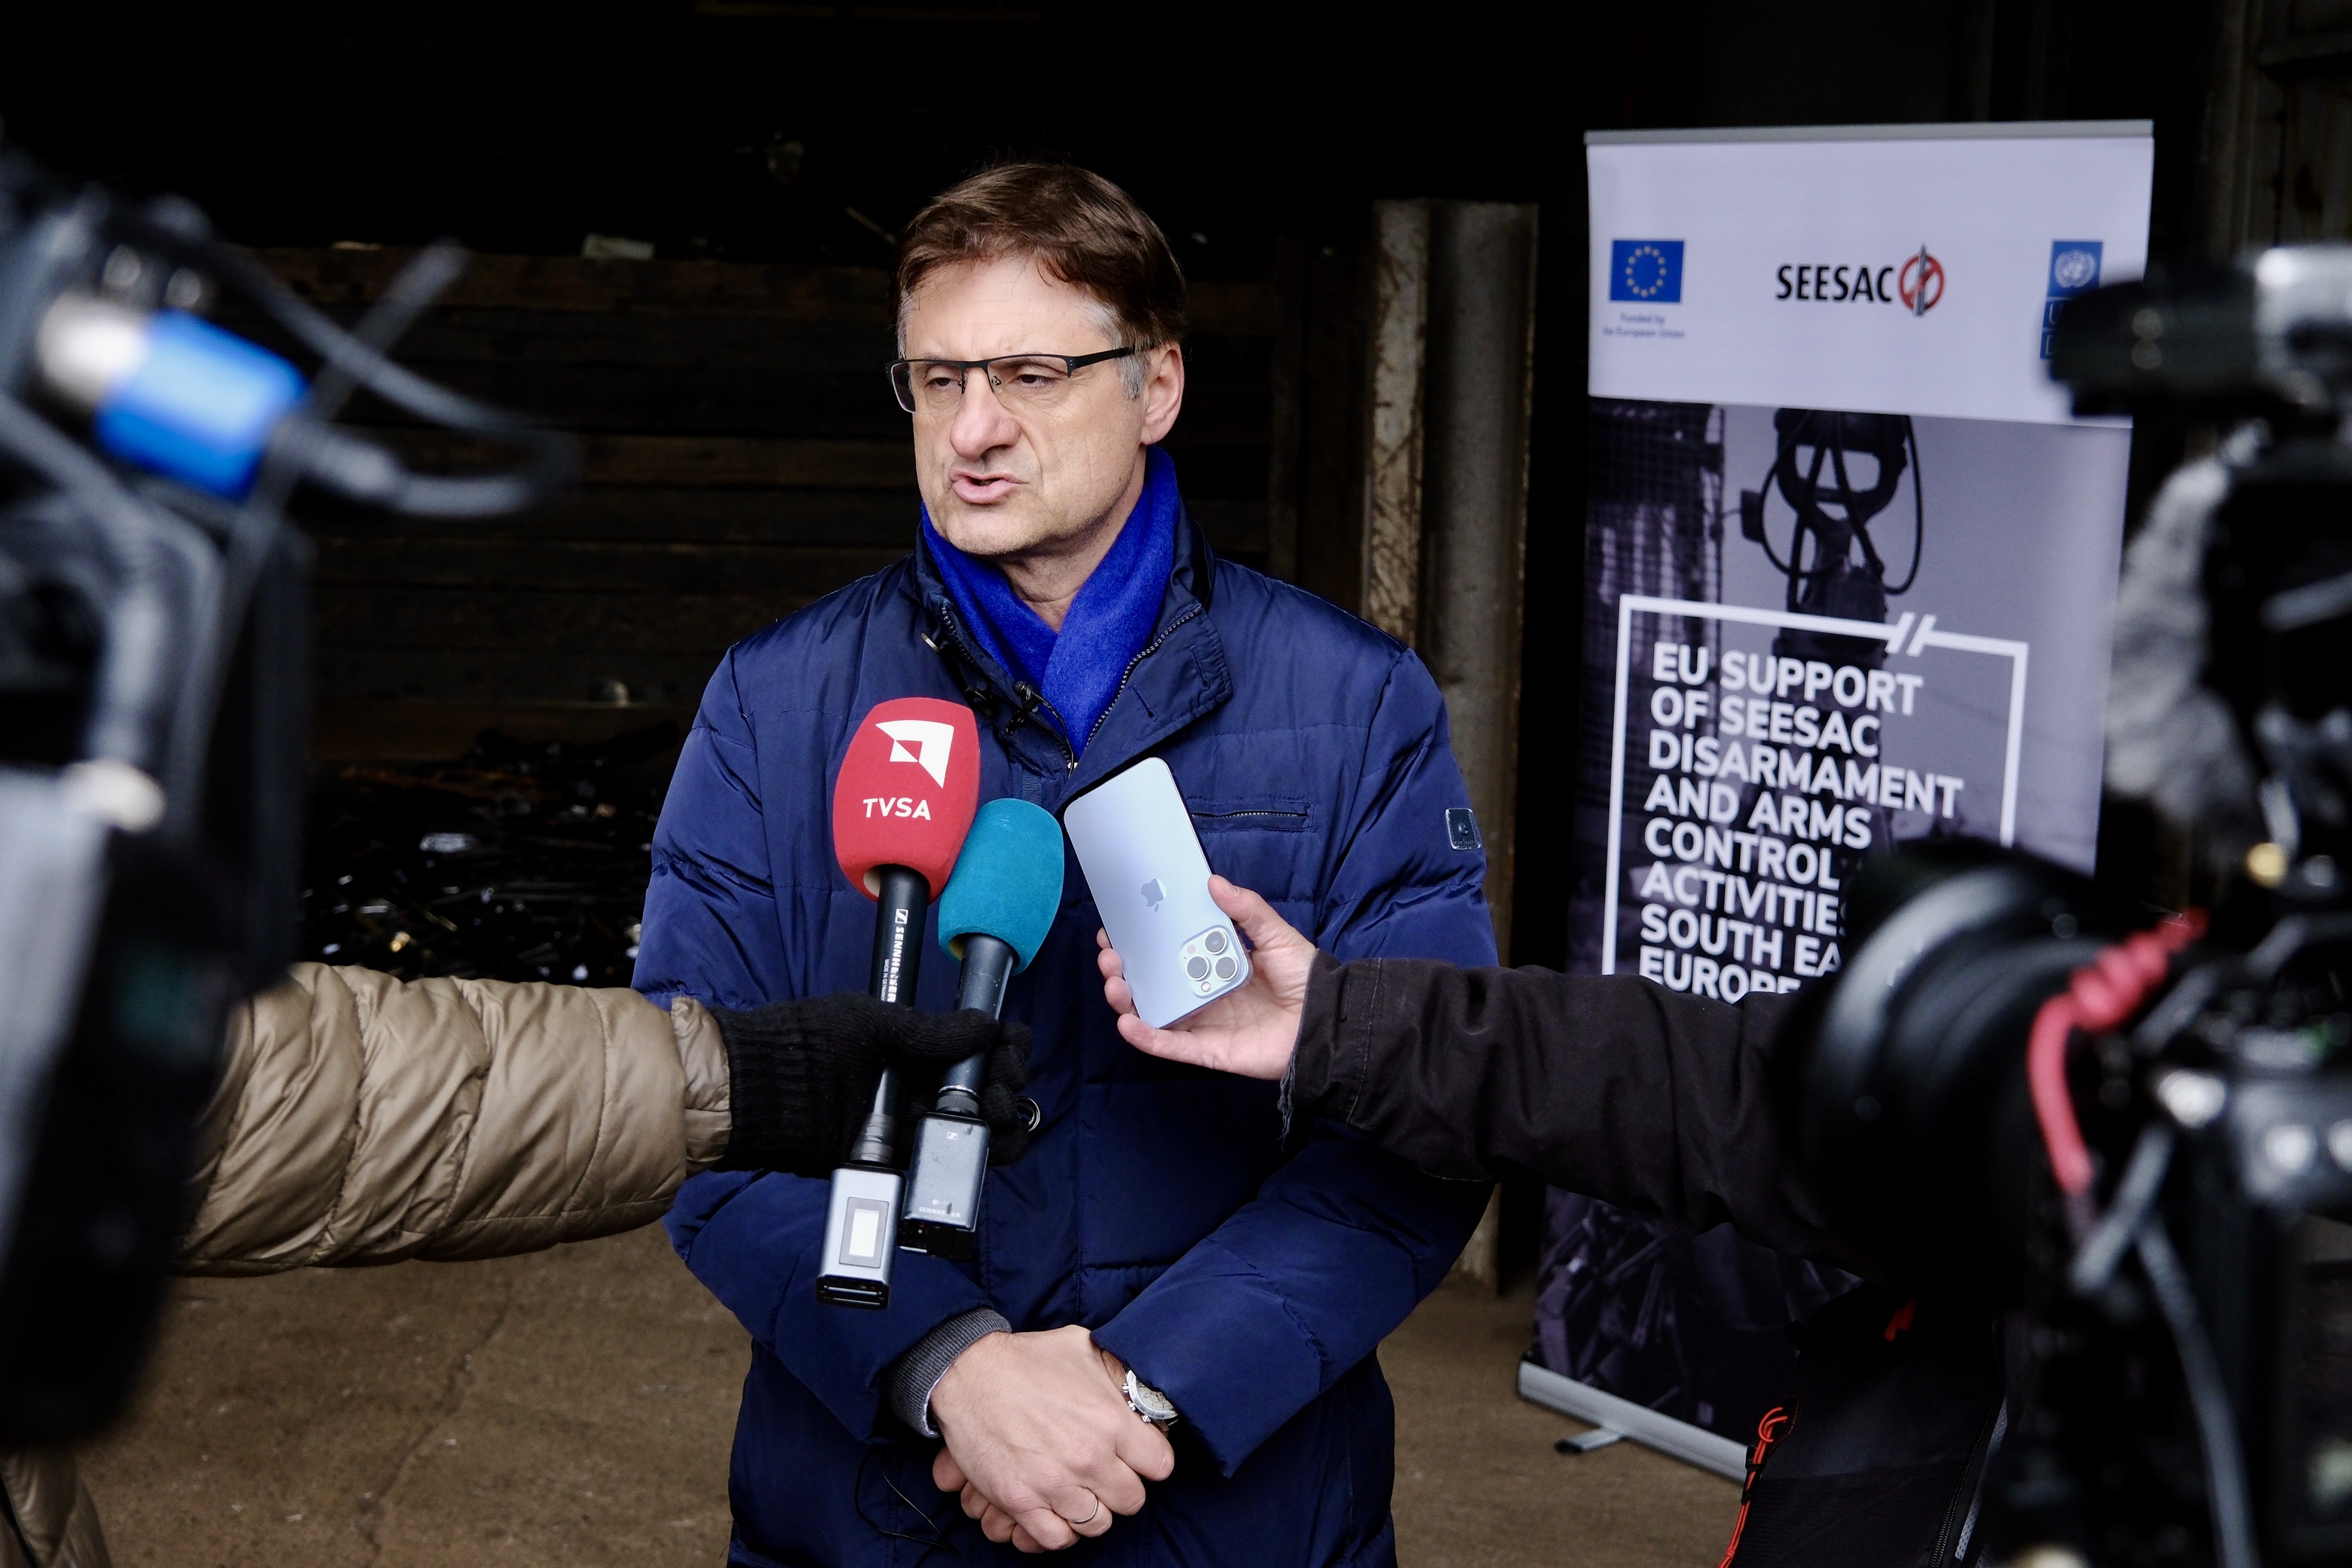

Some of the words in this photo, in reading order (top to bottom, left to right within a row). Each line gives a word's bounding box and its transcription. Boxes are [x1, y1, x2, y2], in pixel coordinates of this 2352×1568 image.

[1776, 265, 1894, 302] SEESAC
[1652, 641, 1709, 685] EU
[1720, 650, 1924, 716] SUPPORT
[1650, 685, 1709, 730] OF
[1720, 695, 1880, 757] SEESAC
[862, 797, 931, 821] TVSA
[1648, 728, 1964, 819] DISARMAMENT
[1644, 775, 1740, 823] AND
[1748, 796, 1872, 850] ARMS
[1644, 818, 1839, 890] CONTROL
[887, 926, 905, 1003] SENNHEISER
[1640, 903, 1784, 969] SOUTH
[1793, 934, 1842, 978] EA
[918, 1206, 961, 1218] SENNHEER
